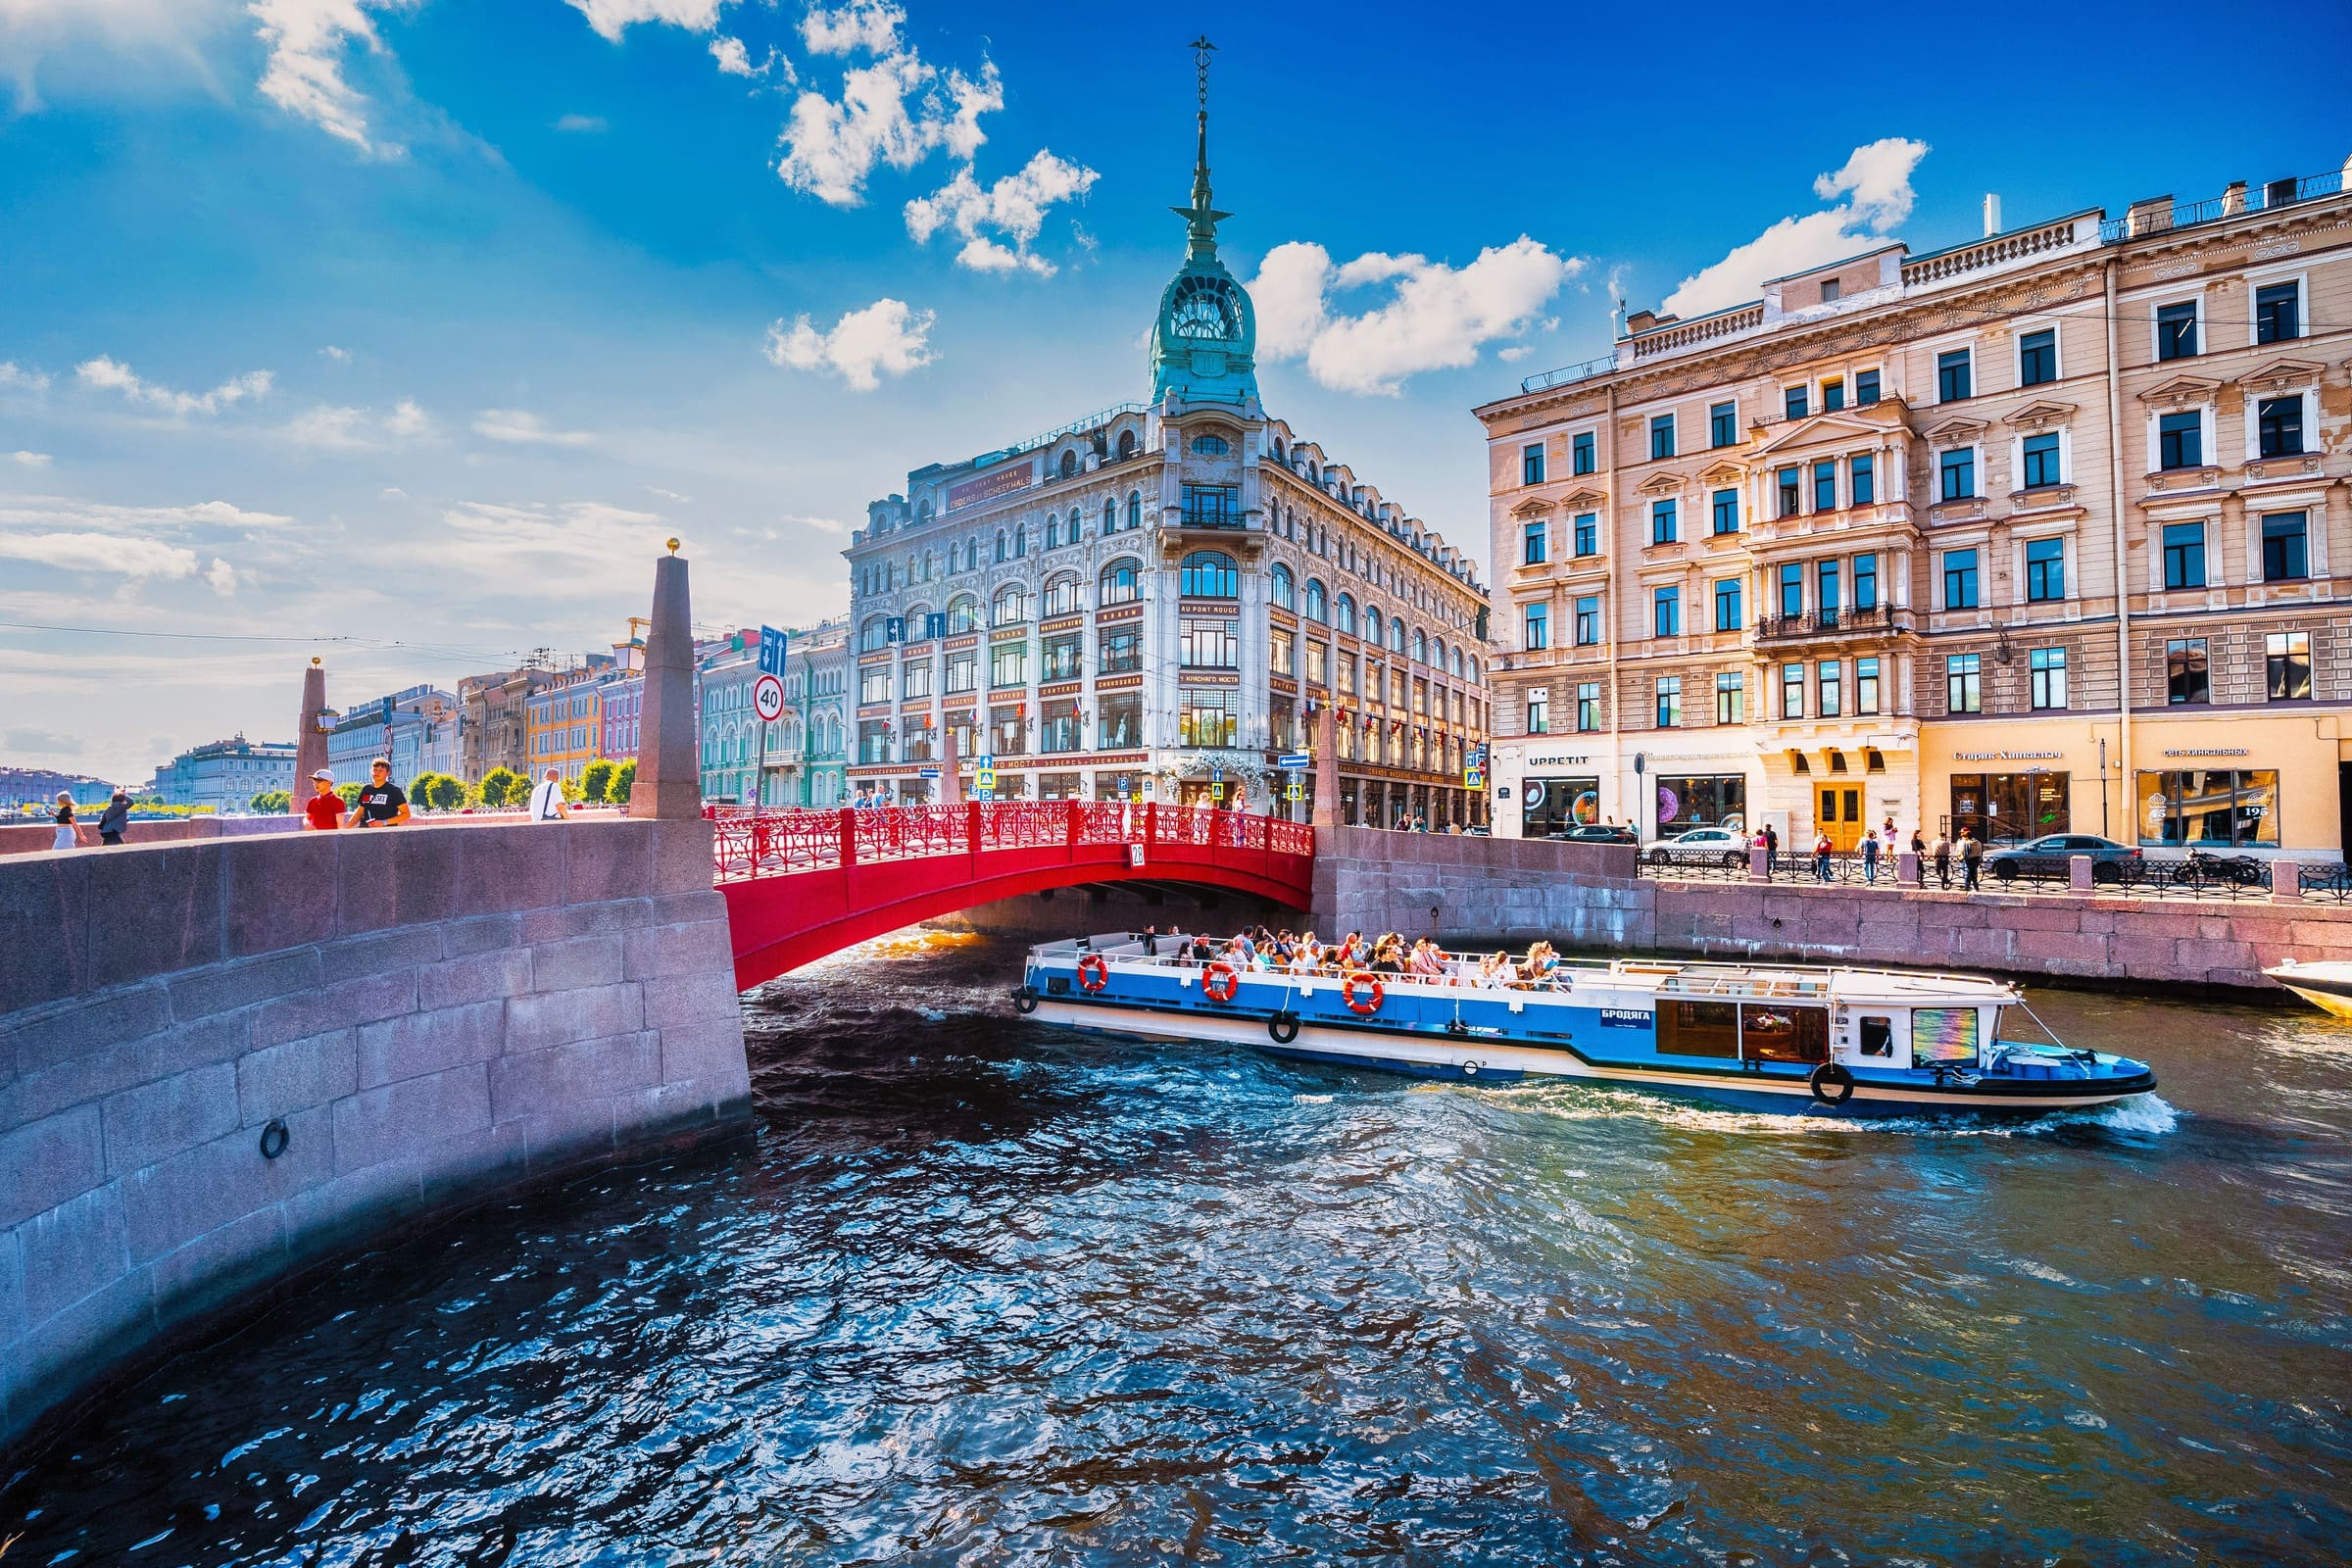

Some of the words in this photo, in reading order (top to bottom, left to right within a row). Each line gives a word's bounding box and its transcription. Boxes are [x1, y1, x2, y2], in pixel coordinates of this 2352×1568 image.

[760, 689, 777, 708] 40
[1953, 752, 1996, 760] Старик
[1998, 750, 2062, 760] Хинкалыч
[2186, 748, 2248, 757] хинкальных
[1007, 760, 1037, 768] МОСТА
[1530, 757, 1589, 765] UPPETIT
[2245, 808, 2268, 816] 195
[1133, 846, 1143, 863] 28
[1602, 1009, 1650, 1020] БРОДЯГА
